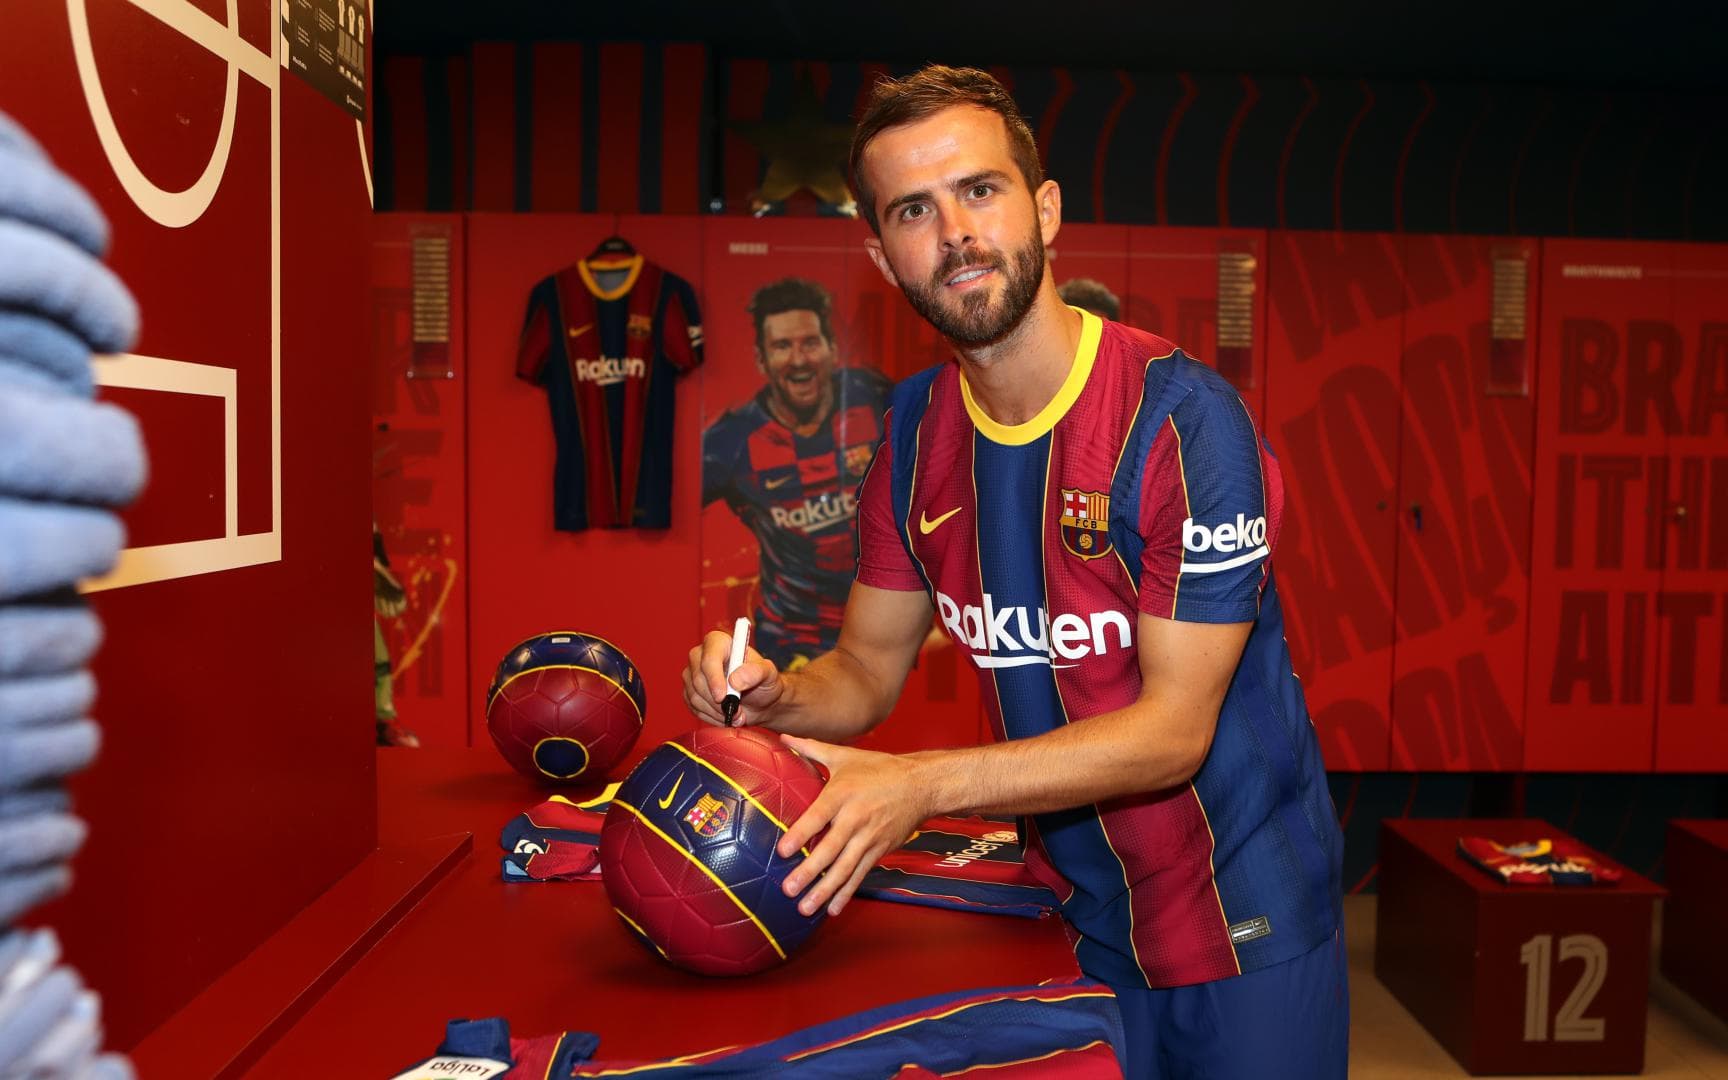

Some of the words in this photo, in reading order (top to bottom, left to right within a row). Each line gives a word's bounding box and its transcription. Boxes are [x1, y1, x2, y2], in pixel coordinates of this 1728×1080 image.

[575, 354, 645, 382] Rakun
[770, 493, 857, 528] Rakut
[1075, 518, 1097, 529] FCB
[1182, 512, 1267, 553] beko
[936, 591, 1132, 660] Rakuen
[1549, 590, 1728, 706] AIT
[934, 839, 1004, 868] unicef
[1519, 933, 1608, 1041] 12
[430, 1060, 490, 1077] LaLiga
